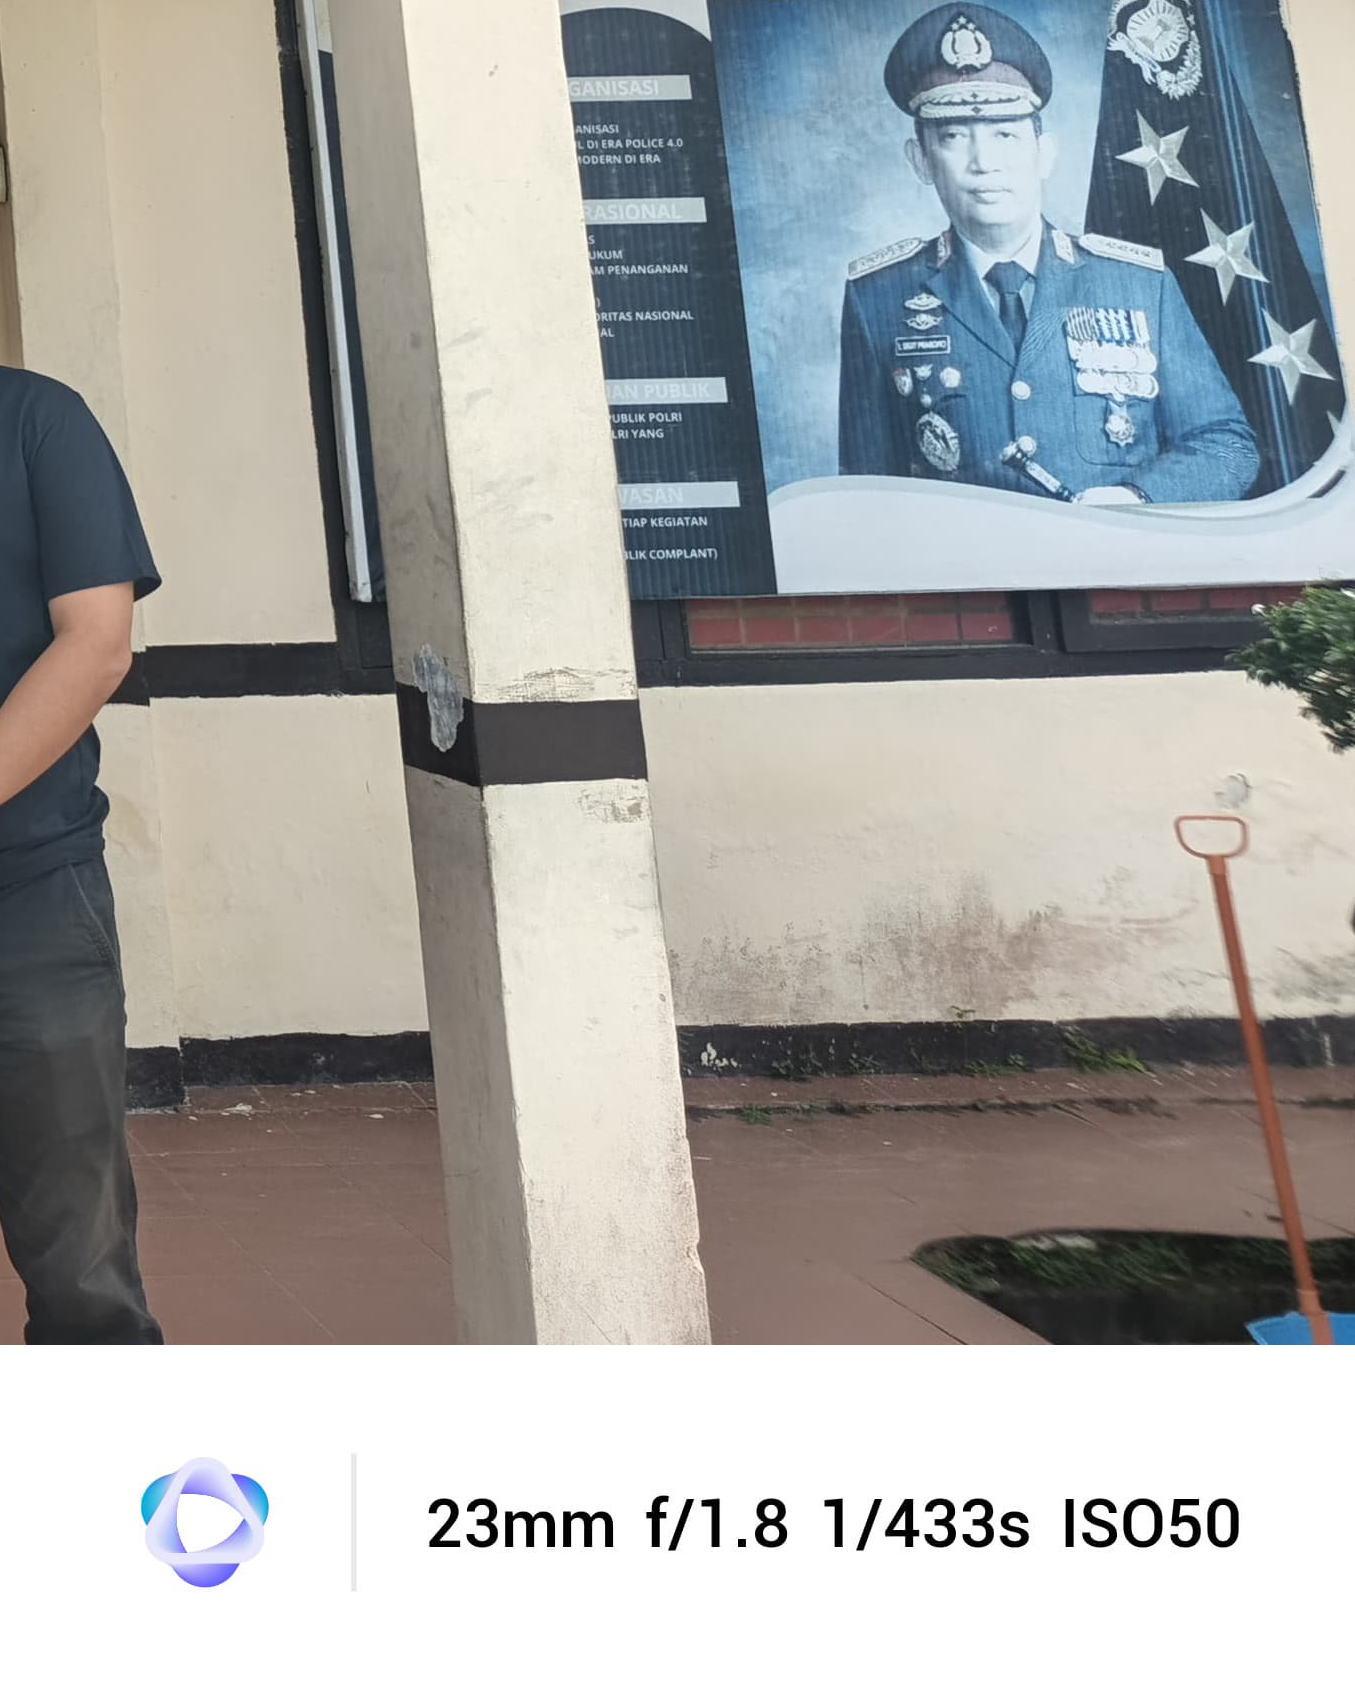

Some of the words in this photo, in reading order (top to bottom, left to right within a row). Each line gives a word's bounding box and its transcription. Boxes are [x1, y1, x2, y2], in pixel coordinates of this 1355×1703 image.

[569, 79, 659, 96] GANISASI
[575, 124, 620, 134] ANISASI
[587, 139, 599, 149] DI
[601, 138, 622, 149] ERA
[625, 138, 664, 148] POLICE
[666, 137, 684, 148] 4.0
[624, 154, 637, 164] DI
[640, 153, 661, 163] ERA
[607, 264, 689, 274] PENANGANAN
[635, 310, 694, 321] NASIONAL
[643, 383, 710, 398] PUBLIK
[649, 412, 683, 422] POLRI
[632, 429, 665, 439] YANG
[651, 516, 708, 527] KEGIATAN
[649, 548, 718, 560] COMPLANT)
